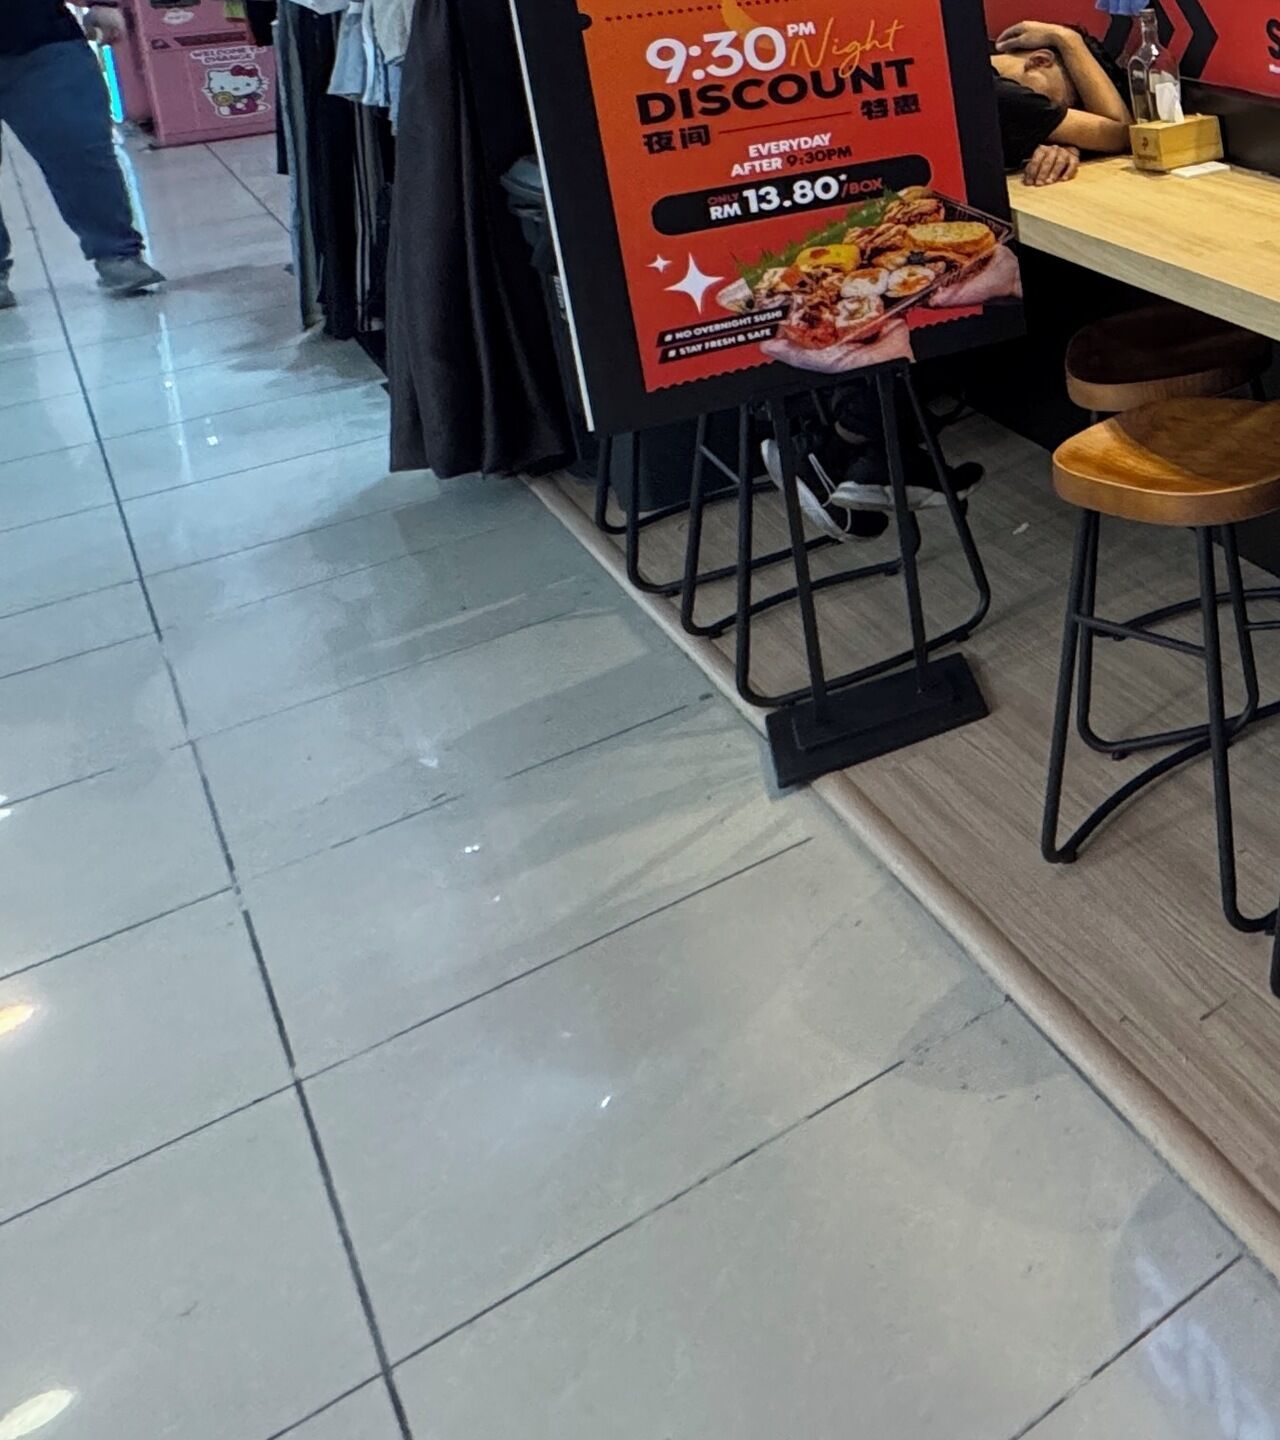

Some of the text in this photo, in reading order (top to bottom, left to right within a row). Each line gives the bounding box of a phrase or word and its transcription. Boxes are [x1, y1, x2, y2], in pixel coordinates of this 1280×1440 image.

[646, 17, 905, 84] 9:30 PM Night
[636, 57, 914, 125] DISCOUNT
[860, 93, 921, 120] 特惠
[642, 124, 710, 154] 夜间
[748, 133, 832, 158] EVERYDAY
[731, 145, 853, 178] AFTER 9:30PM
[707, 192, 739, 206] ONLY
[710, 204, 742, 221] RM
[841, 178, 883, 198] /BOX
[675, 330, 692, 340] NO
[693, 316, 752, 336] OVERNIGHT
[754, 310, 782, 323] SUSHI
[679, 344, 702, 356] STAY
[705, 336, 736, 350] FRESH
[747, 328, 772, 340] SAFE
